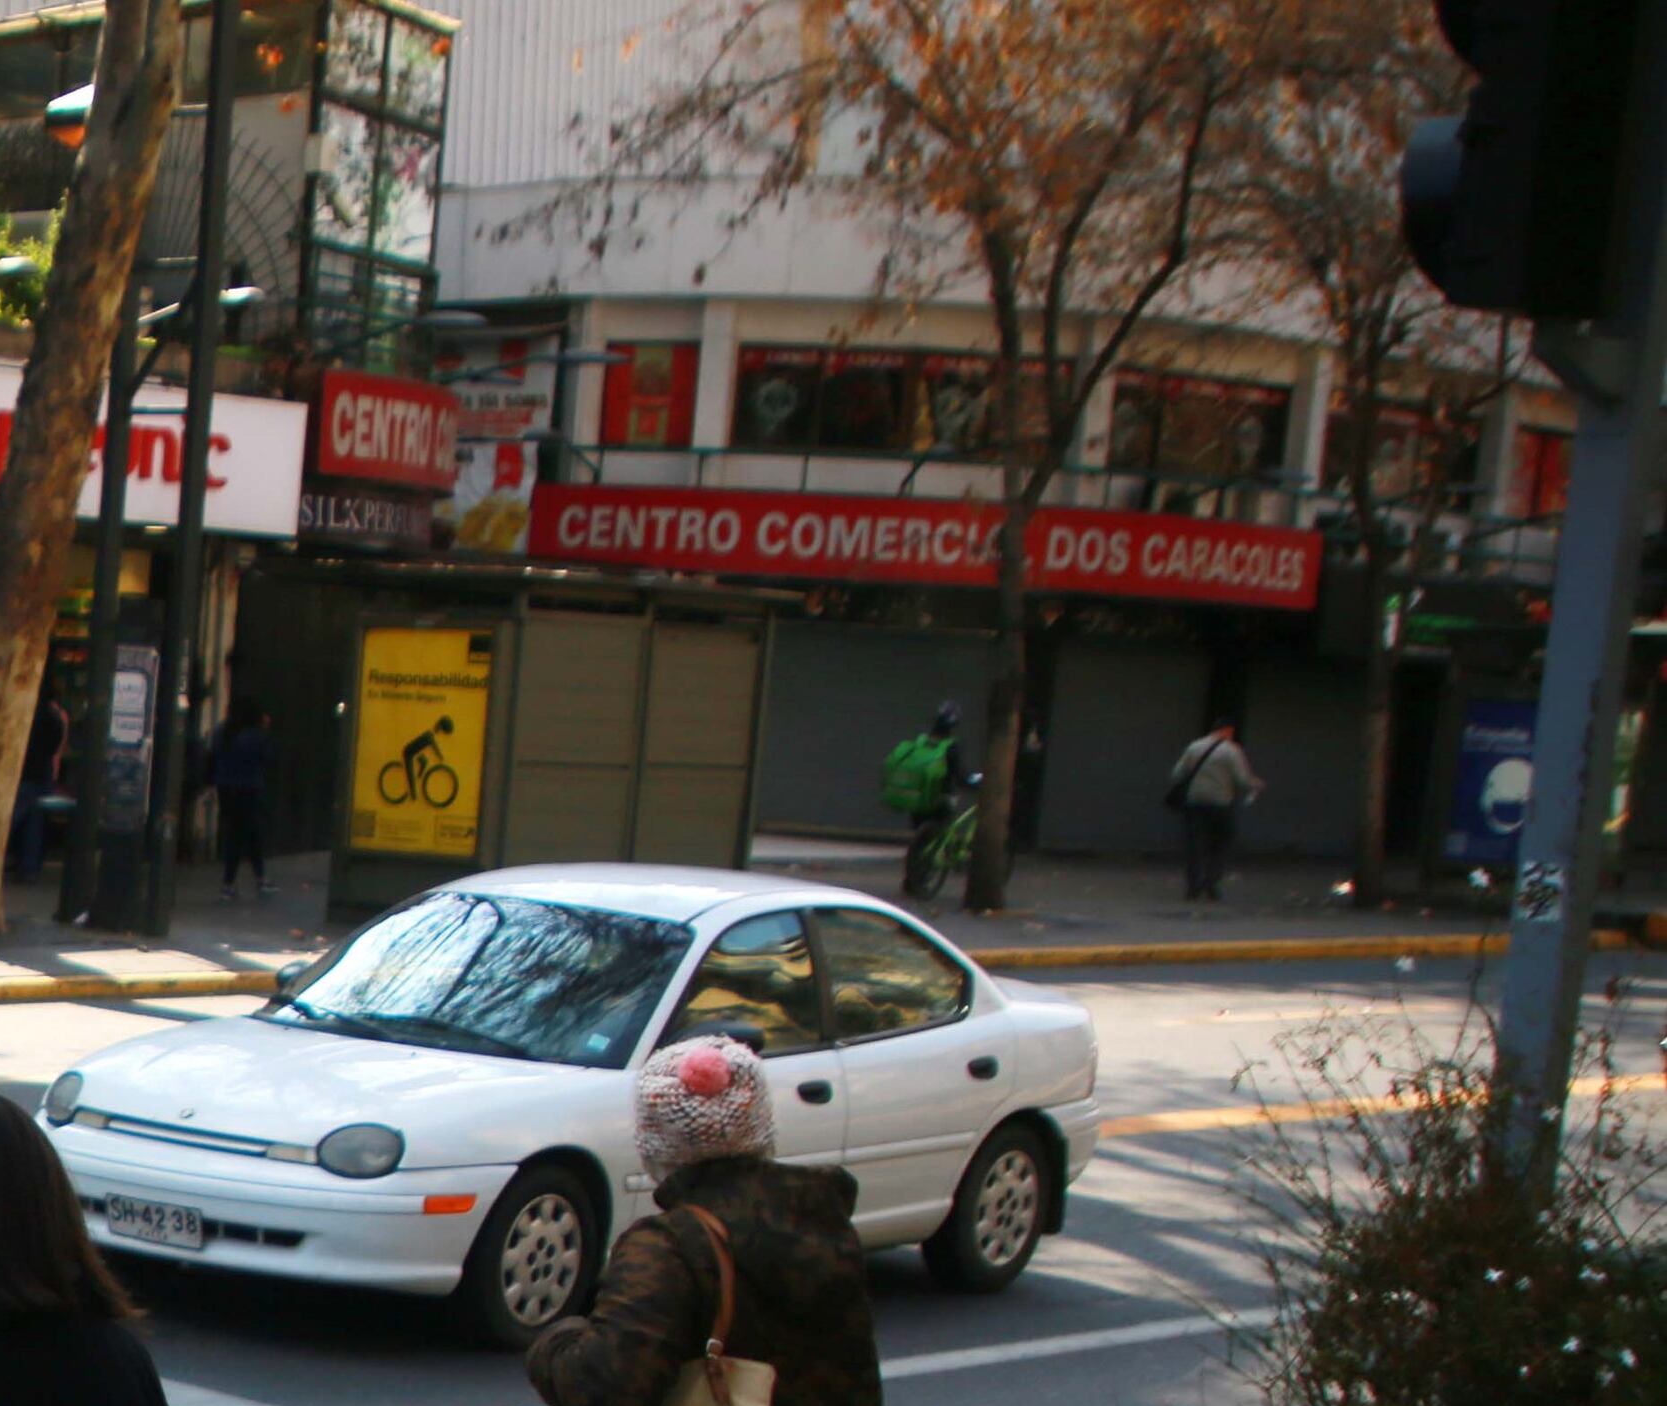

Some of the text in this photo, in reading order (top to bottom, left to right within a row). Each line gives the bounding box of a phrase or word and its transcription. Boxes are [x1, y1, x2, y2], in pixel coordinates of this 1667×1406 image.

[332, 390, 434, 467] CENTRO
[299, 494, 362, 529] SILK
[557, 503, 1307, 592] CENTRO COMERCIA DOS CARACOLES
